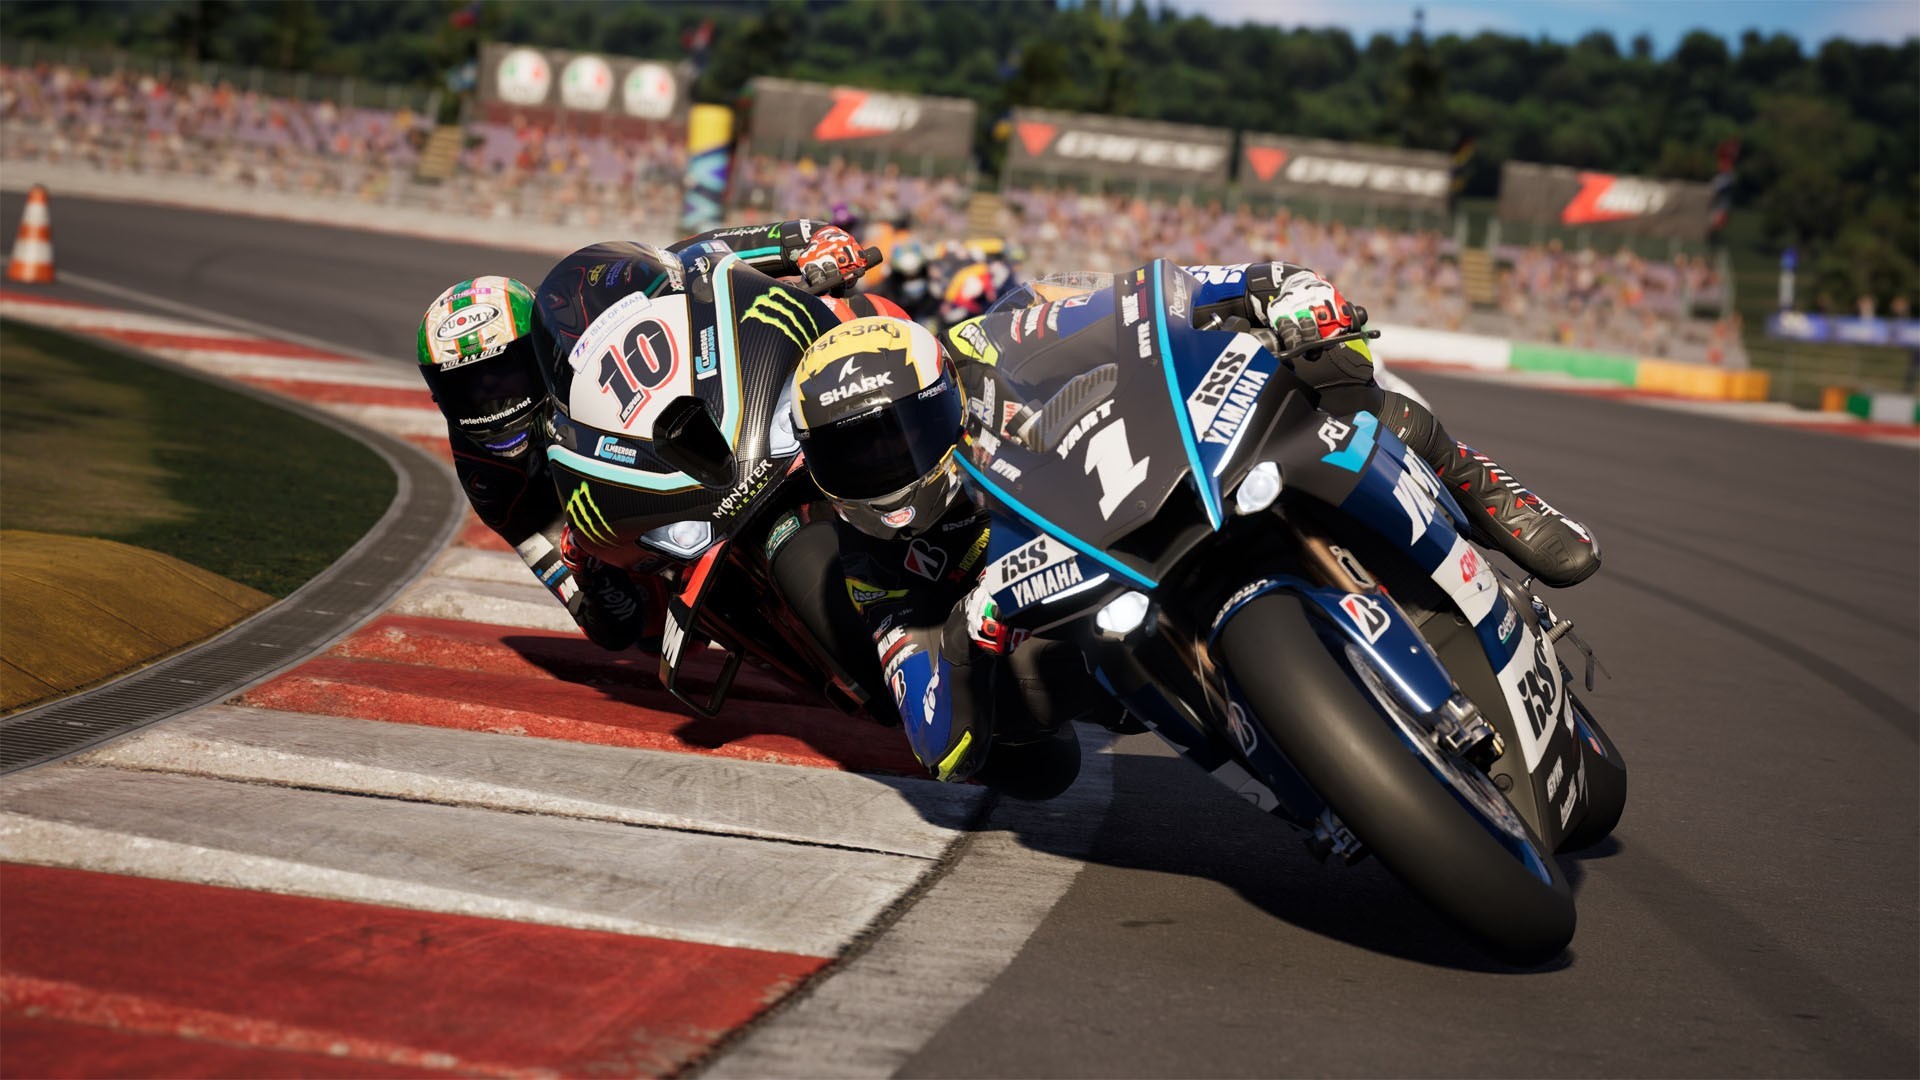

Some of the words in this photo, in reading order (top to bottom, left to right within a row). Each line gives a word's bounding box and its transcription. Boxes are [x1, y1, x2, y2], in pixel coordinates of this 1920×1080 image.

[597, 318, 679, 429] 10
[818, 370, 894, 407] SHARK
[459, 396, 532, 426] peterhickman.net
[1055, 399, 1115, 461] YART
[1203, 368, 1270, 446] YAMAHA
[712, 458, 773, 520] MONSTER
[728, 474, 771, 517] ENERGY
[1084, 417, 1150, 522] 1
[1011, 559, 1084, 609] YAMAHA
